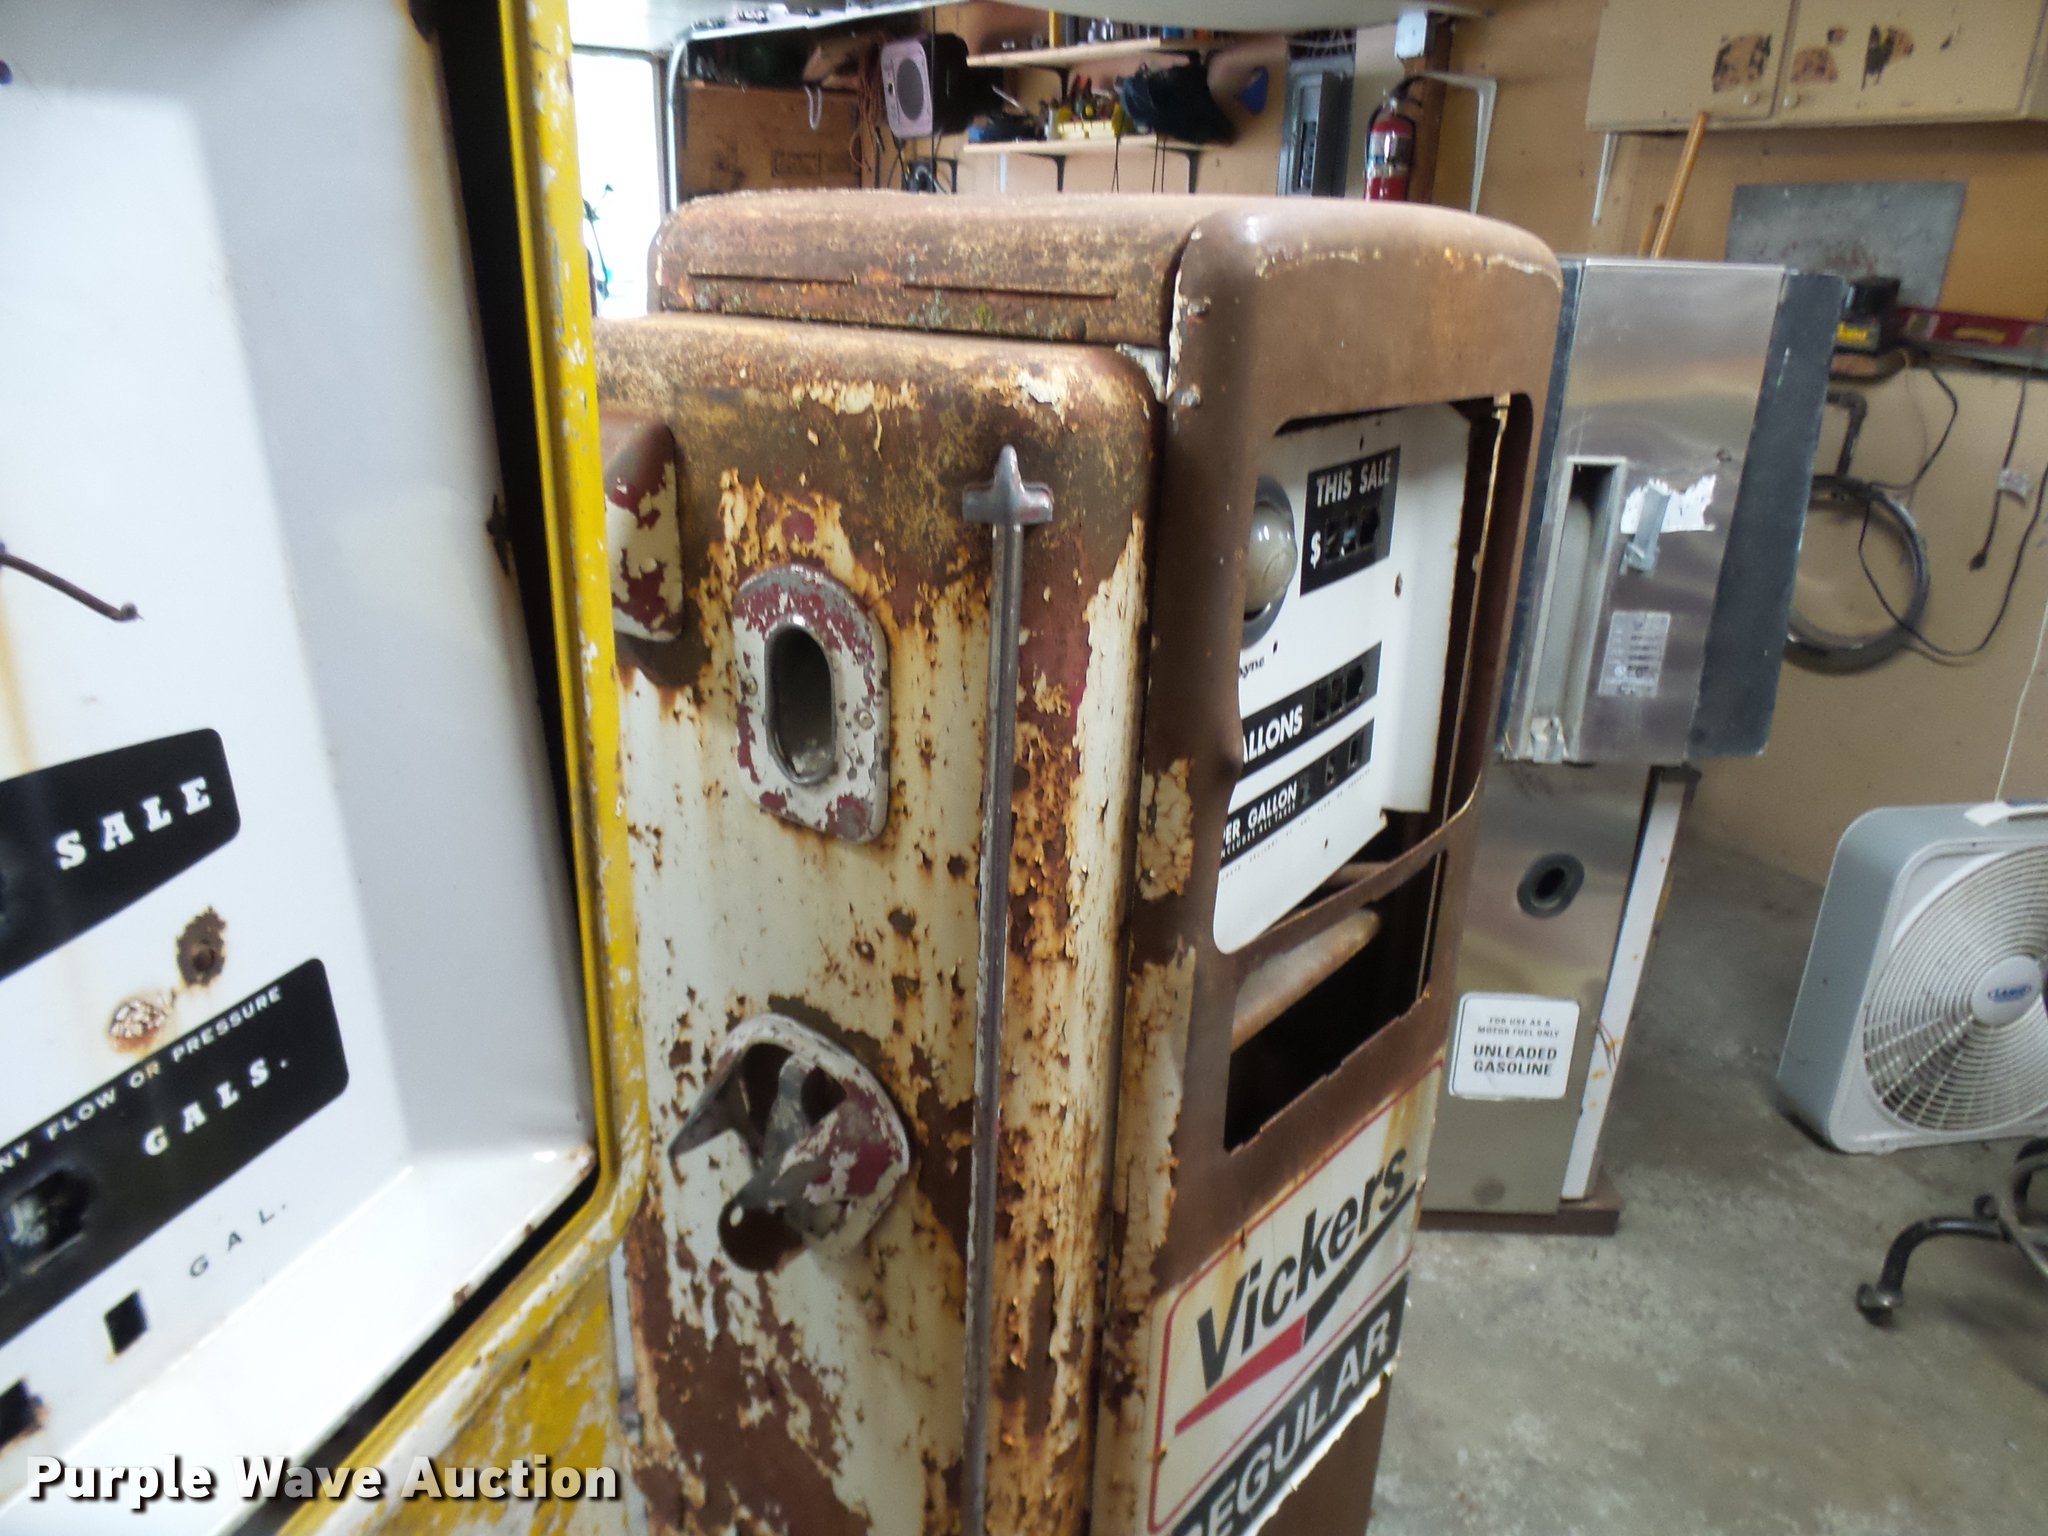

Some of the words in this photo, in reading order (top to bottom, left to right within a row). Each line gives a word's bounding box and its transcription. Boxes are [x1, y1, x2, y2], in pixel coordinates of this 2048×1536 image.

[1316, 468, 1352, 508] THIS
[1359, 455, 1391, 494] SALE
[1310, 530, 1321, 569] $
[54, 776, 212, 870] SALE
[1223, 817, 1241, 845] ER
[1248, 781, 1298, 830] GALLON
[1473, 1043, 1557, 1061] UNLEADED
[1477, 1026, 1510, 1035] MOTOR
[1513, 1028, 1533, 1037] FUEL
[1537, 1029, 1559, 1038] ONLY
[1489, 1017, 1506, 1025] FOR
[1509, 1018, 1526, 1026] USE
[1530, 1018, 1541, 1027] AS
[45, 1088, 117, 1141] FLOW
[129, 1062, 161, 1089] OR
[172, 985, 282, 1063] PRESSURE
[1473, 1060, 1552, 1076] GASOLINE
[143, 1057, 289, 1157] GALS.
[188, 1203, 287, 1280] GAL.
[1197, 1148, 1407, 1392] Vickers
[1184, 1309, 1390, 1536] EGULAR
